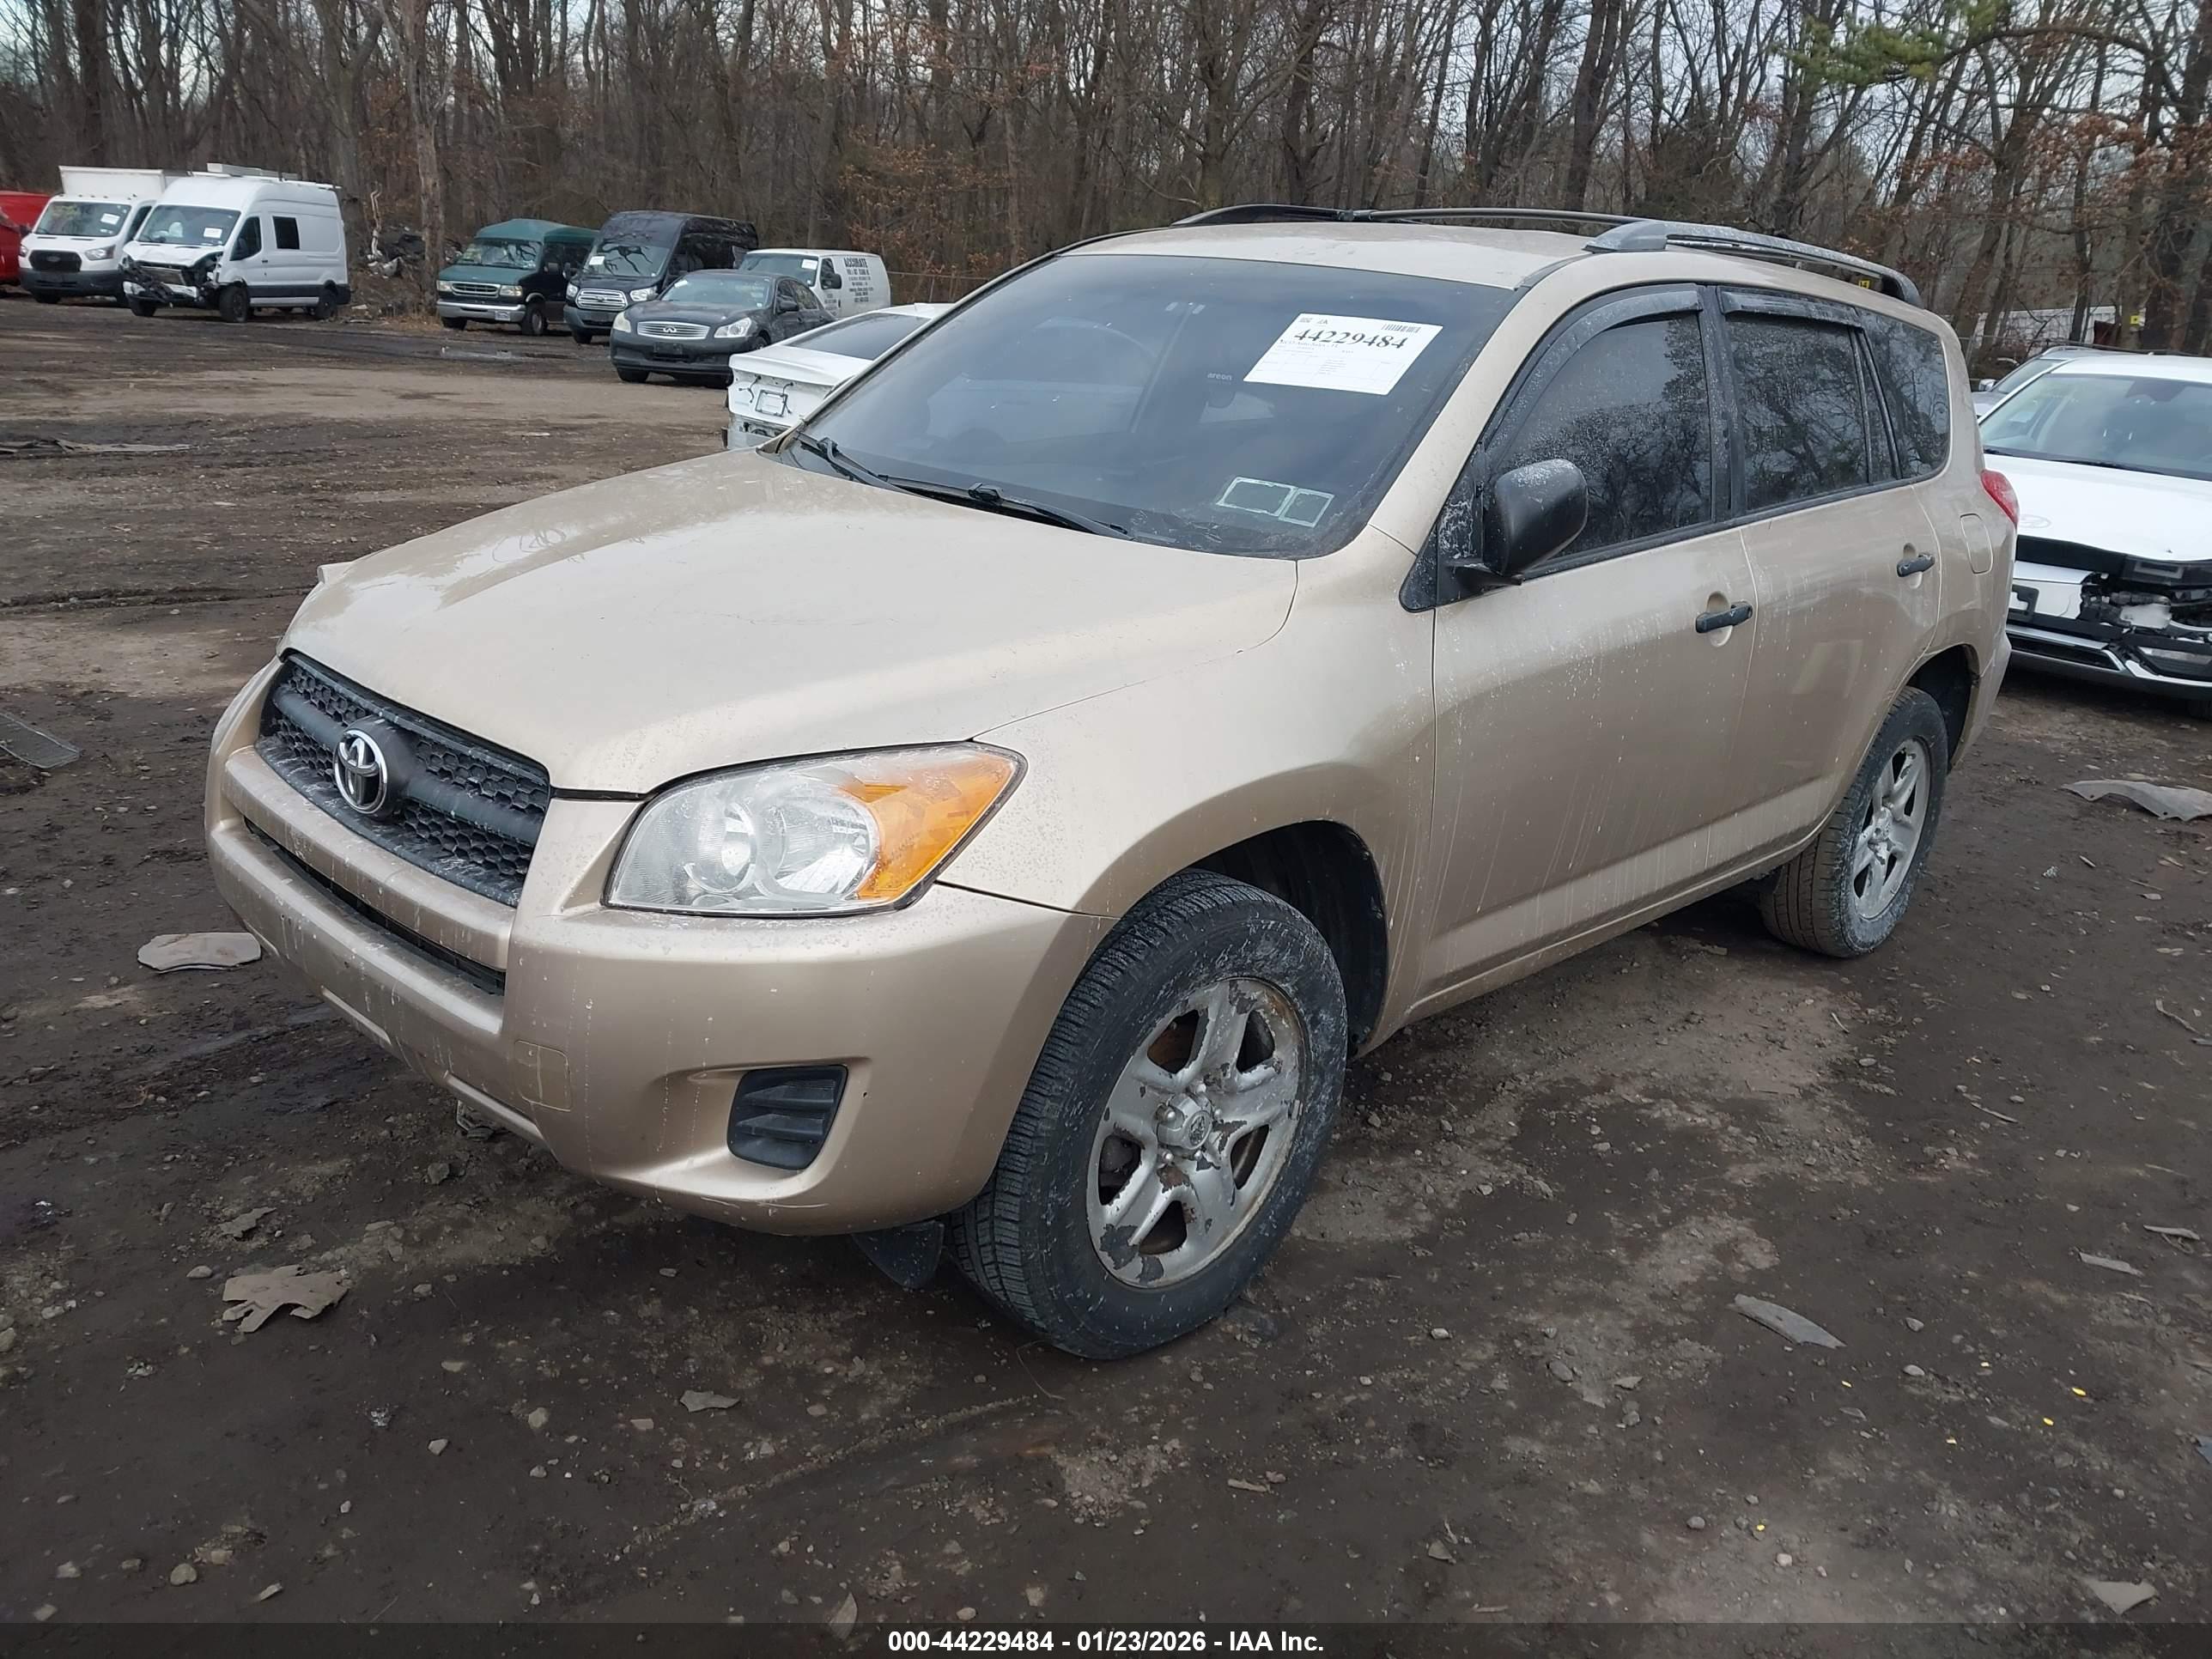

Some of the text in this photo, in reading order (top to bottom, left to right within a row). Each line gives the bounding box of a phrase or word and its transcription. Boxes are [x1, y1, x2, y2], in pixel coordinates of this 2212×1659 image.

[843, 258, 868, 268] ACCURATE
[1294, 328, 1408, 349] 44229484
[1207, 372, 1232, 381] areon
